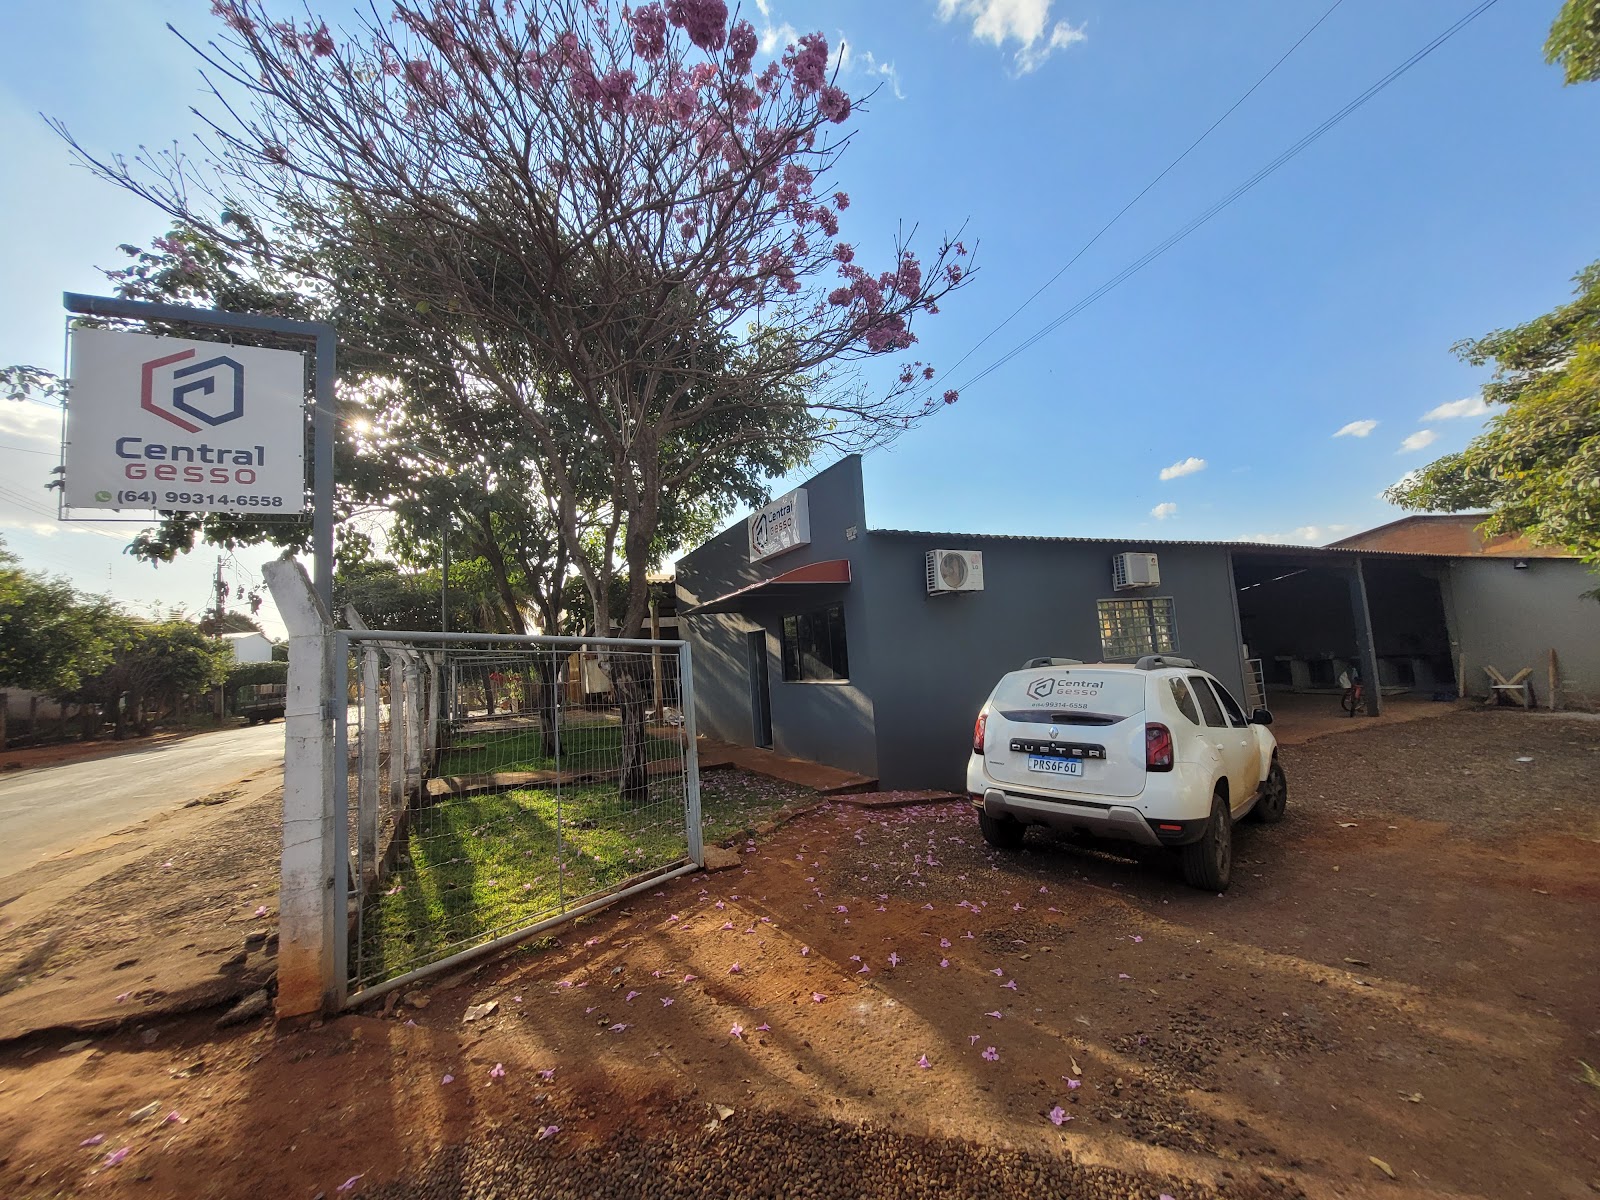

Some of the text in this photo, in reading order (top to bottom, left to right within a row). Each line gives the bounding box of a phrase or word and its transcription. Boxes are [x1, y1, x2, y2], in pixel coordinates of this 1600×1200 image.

[115, 437, 264, 466] Central
[117, 490, 283, 507] (64) 99314-6558
[768, 501, 793, 523] Central
[1057, 680, 1104, 689] Central
[1045, 701, 1088, 709] 99314-6558
[1011, 743, 1100, 758] DUSTER
[1033, 759, 1077, 773] PRS6F60
